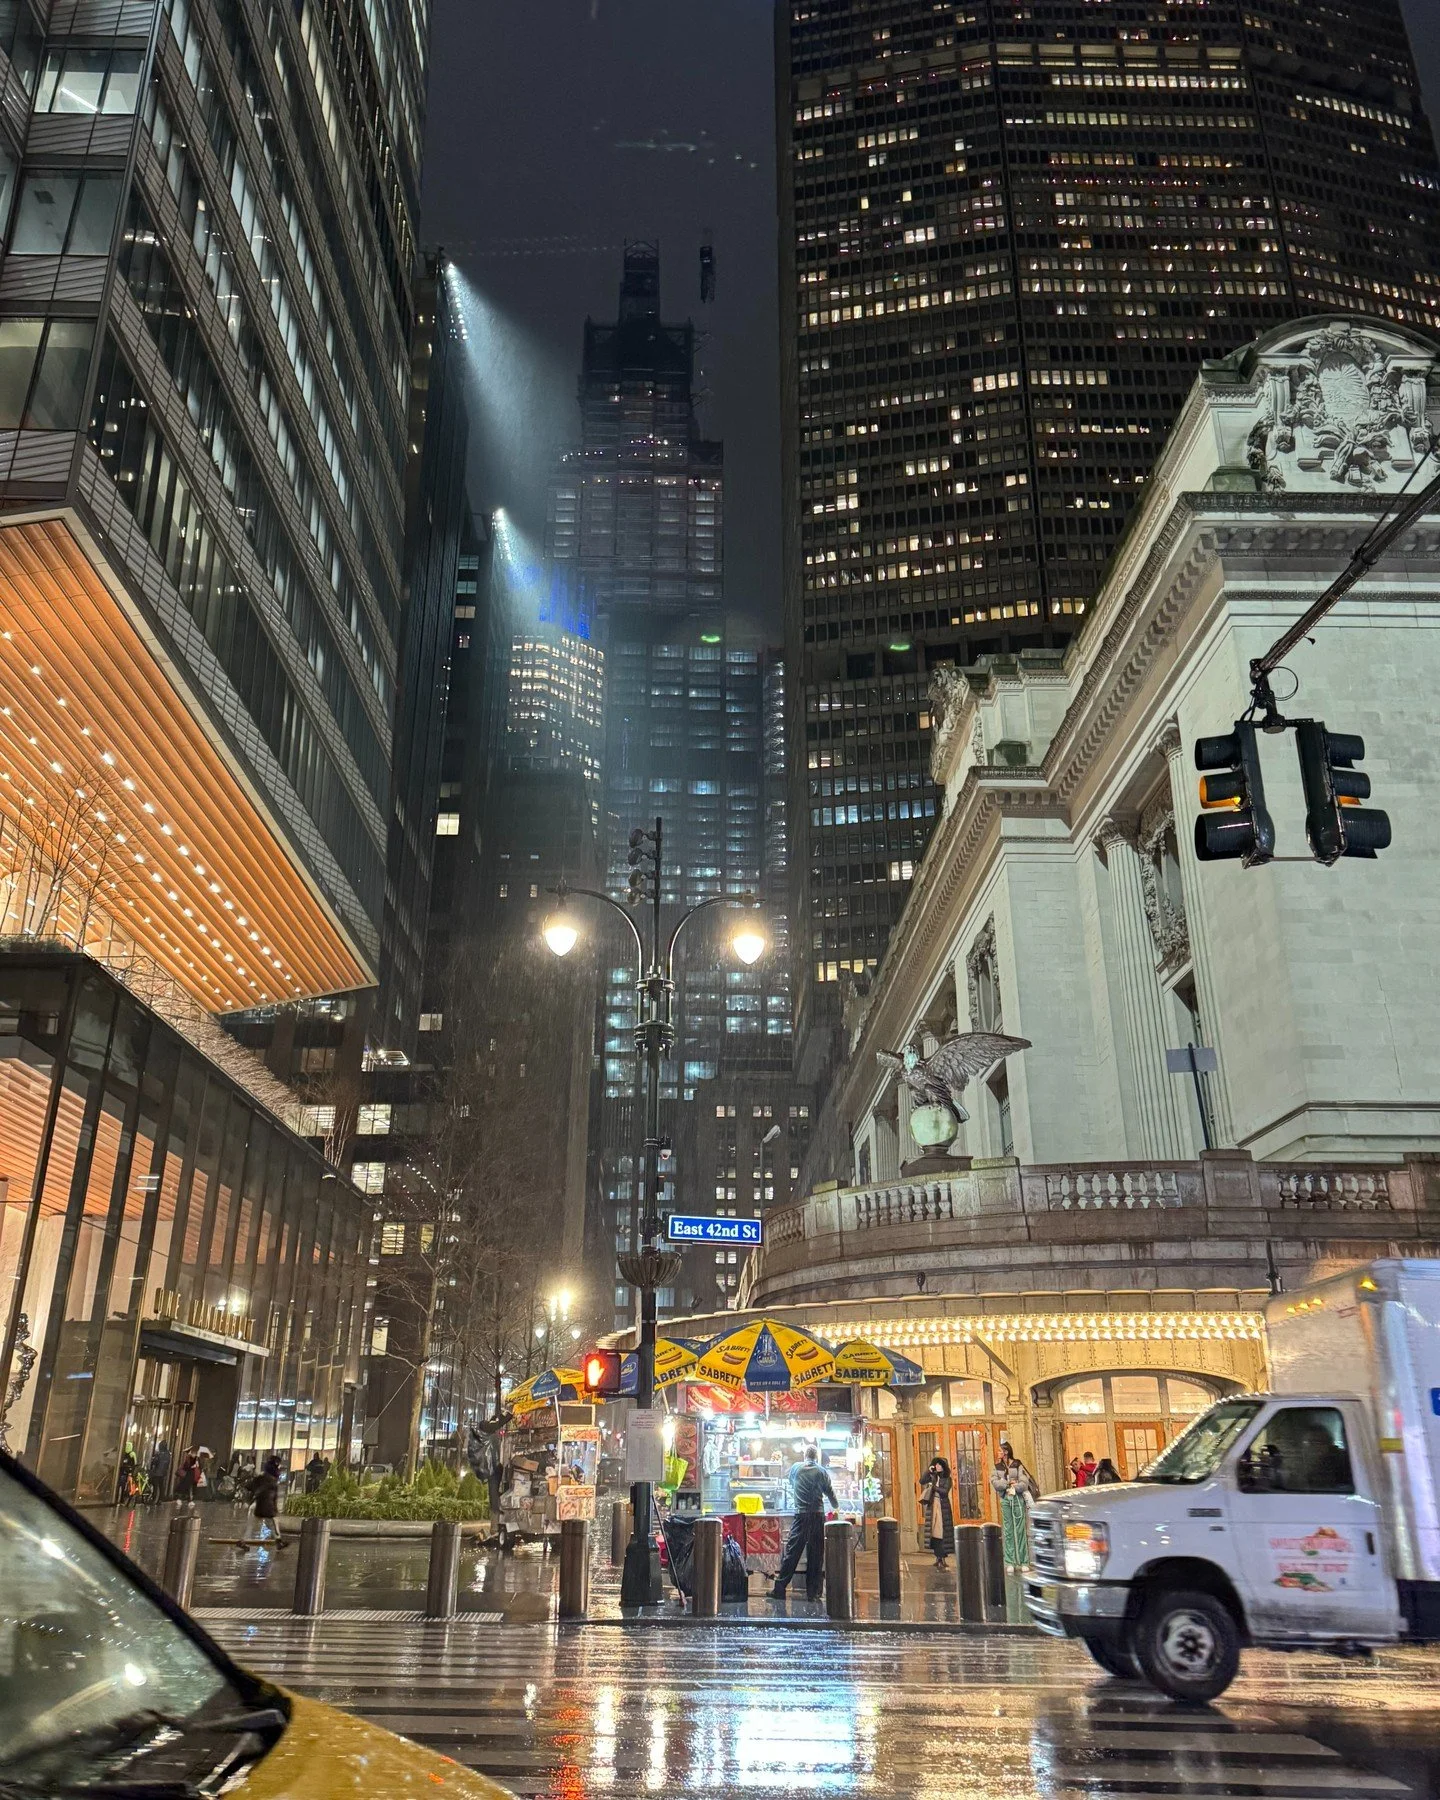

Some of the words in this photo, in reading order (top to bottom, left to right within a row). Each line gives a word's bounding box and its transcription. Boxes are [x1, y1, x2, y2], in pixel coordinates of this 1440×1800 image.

[673, 1221, 704, 1236] East
[706, 1223, 739, 1237] 42nd
[742, 1224, 757, 1239] St
[155, 1287, 181, 1320] ONE
[716, 1345, 751, 1354] SABRETT
[785, 1339, 809, 1359] SABRETT
[842, 1351, 878, 1360] SABRETT
[654, 1361, 697, 1383] ABRETT
[700, 1365, 742, 1387] SABRETT
[794, 1361, 835, 1385] SABRETT
[835, 1369, 890, 1380] SABRETT
